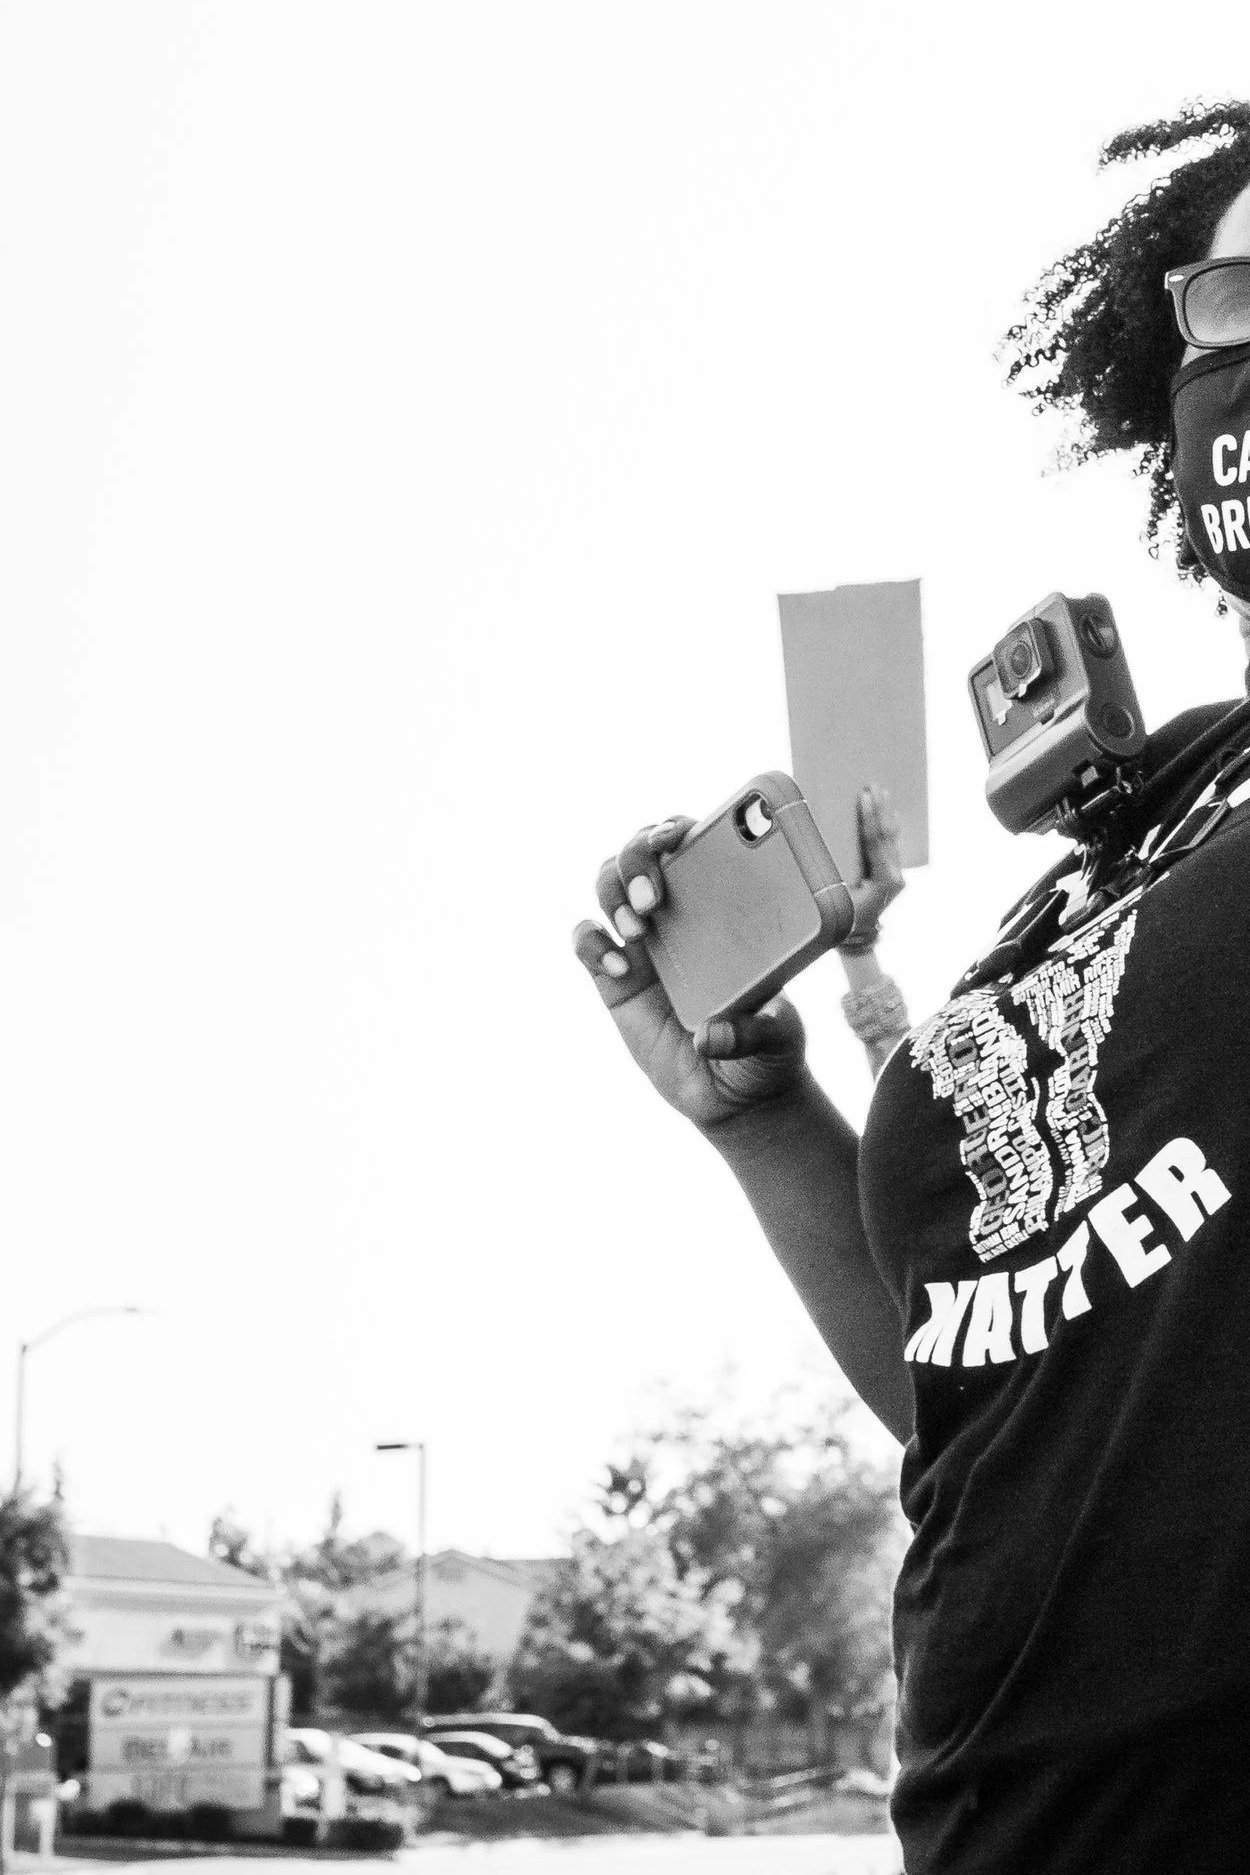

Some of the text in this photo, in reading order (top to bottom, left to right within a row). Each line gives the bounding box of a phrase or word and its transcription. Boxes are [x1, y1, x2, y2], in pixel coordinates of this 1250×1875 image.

[971, 1007, 1006, 1108] BLAND
[987, 1110, 1030, 1225] SANDRA
[903, 1136, 1232, 1367] MATTER
